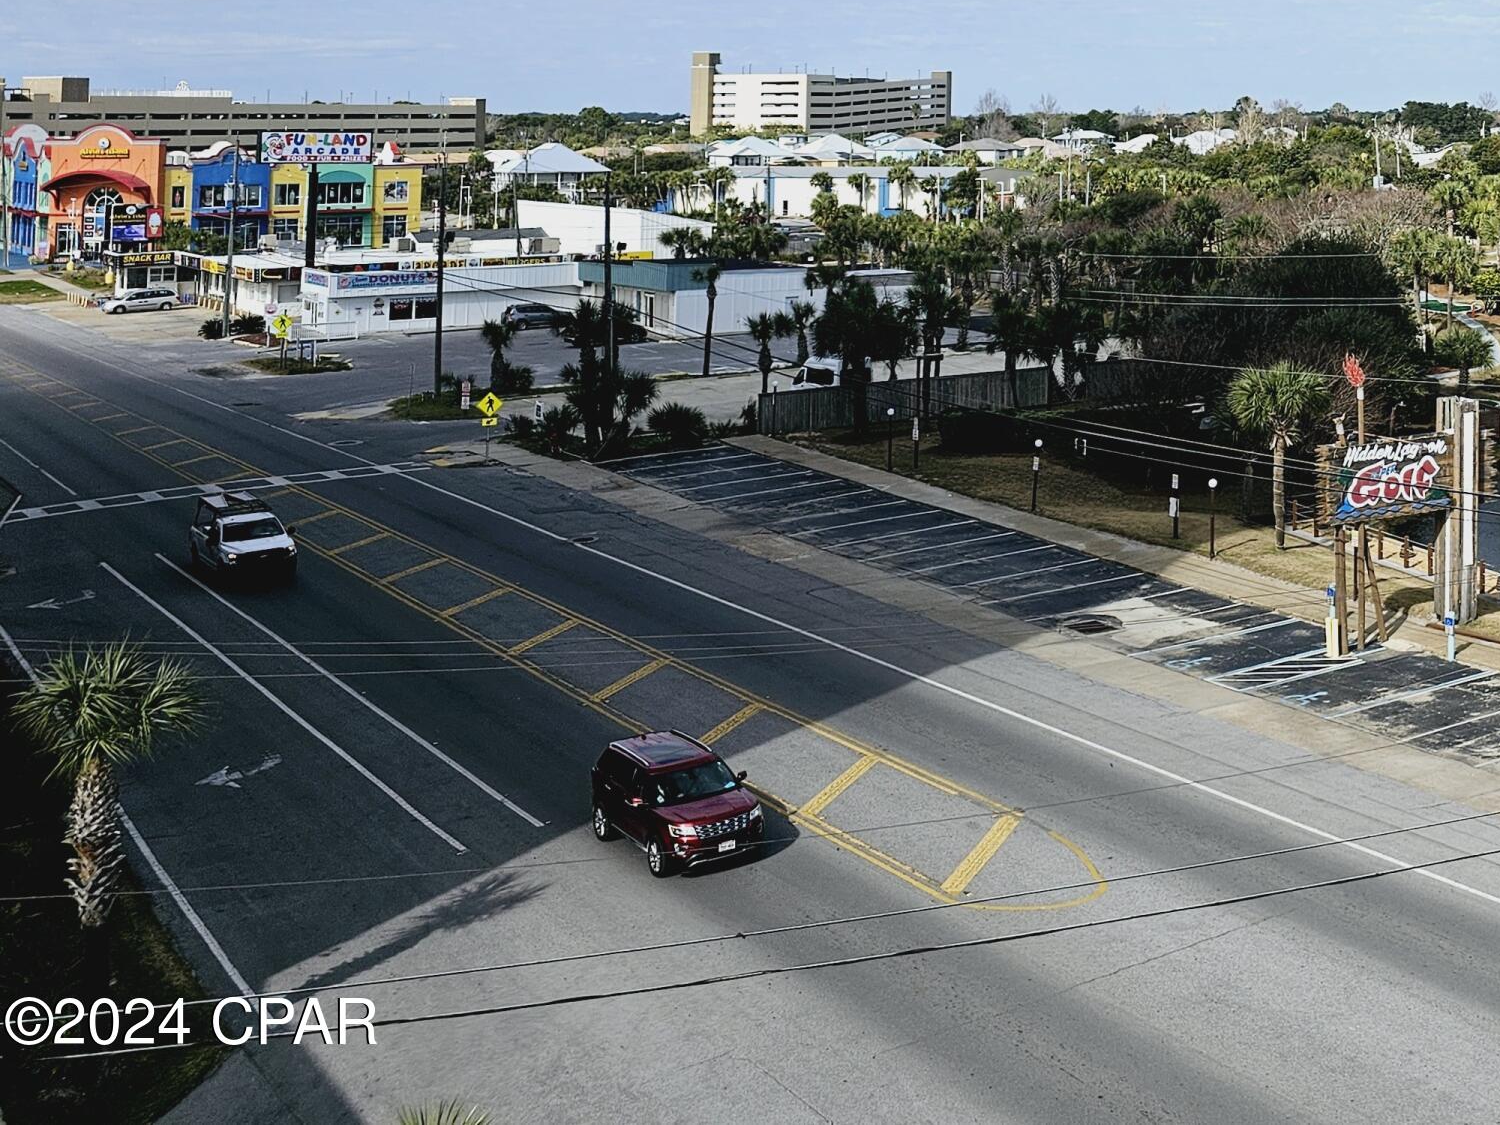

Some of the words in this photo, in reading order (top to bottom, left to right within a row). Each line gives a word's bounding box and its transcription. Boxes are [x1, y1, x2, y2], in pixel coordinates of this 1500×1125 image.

[285, 133, 368, 146] FUN-LAND
[292, 147, 361, 155] ARCADE
[123, 254, 152, 263] SNACK
[154, 253, 172, 262] BAR
[369, 273, 425, 283] DONUTS
[1343, 444, 1394, 467] Hidden
[1393, 439, 1448, 462] Lagon
